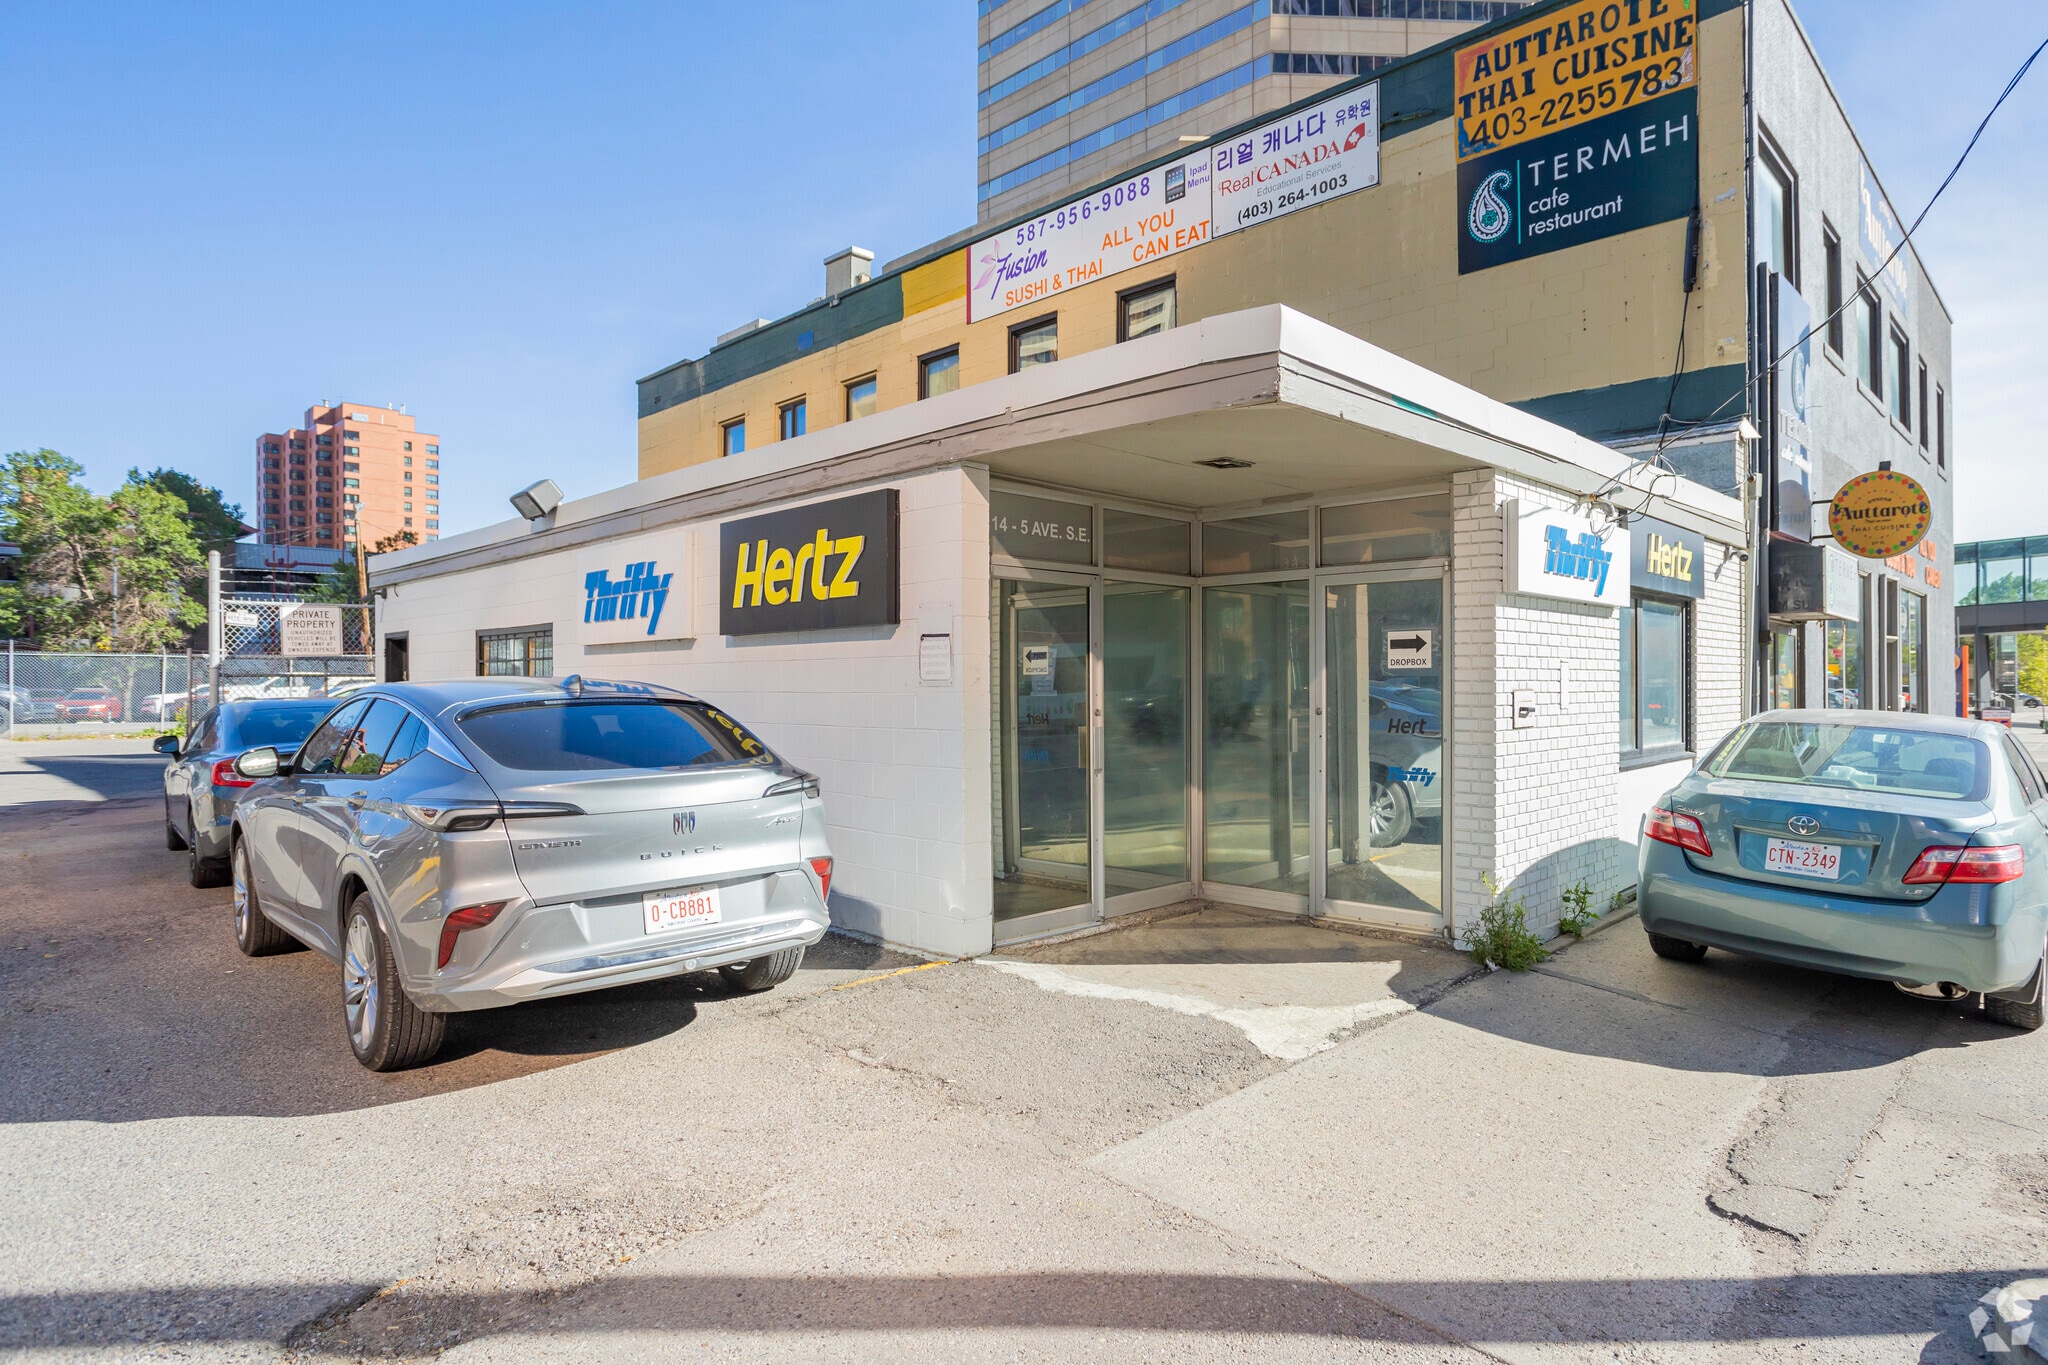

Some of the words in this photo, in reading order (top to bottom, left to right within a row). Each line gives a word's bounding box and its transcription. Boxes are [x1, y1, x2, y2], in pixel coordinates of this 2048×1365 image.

[1473, 0, 1668, 82] AUTTAROTE
[1459, 68, 1535, 120] THAI
[1553, 14, 1693, 85] CUISINE
[1469, 56, 1682, 147] 403-2255783
[1217, 139, 1254, 171] 리얼
[1262, 111, 1327, 155] 캐나다
[1335, 99, 1371, 128] 유학원
[1528, 114, 1689, 187] TERMEH
[1187, 175, 1210, 189] Menu
[1189, 163, 1208, 178] Ipad
[1257, 172, 1304, 197] Educational
[1305, 161, 1342, 180] Services
[1016, 176, 1151, 246] 587-956-9088
[1237, 200, 1273, 225] (403)
[1278, 173, 1348, 208] 264-1003
[1528, 188, 1570, 214] cafe
[1528, 195, 1623, 236] restaurant
[1101, 226, 1134, 251] ALL
[1138, 208, 1175, 237] YOU
[1132, 234, 1169, 263] CAN
[1175, 220, 1210, 249] EAT
[990, 247, 1048, 301] Fusion
[1005, 278, 1048, 307] SUSHI
[1052, 273, 1063, 291] &
[1067, 258, 1103, 285] THAI
[1020, 519, 1028, 535] 5
[1031, 522, 1062, 539] AVE.
[1066, 525, 1091, 543] S.E.
[1840, 503, 1929, 520] Auttarote
[1874, 523, 1911, 531] CUISINE
[732, 528, 866, 609] Hertz
[1544, 524, 1613, 598] Thrifty
[1647, 532, 1693, 583] Hertz
[292, 610, 330, 619] PRIVATE
[584, 560, 673, 636] Thrifty
[286, 620, 335, 628] PROPERTY
[1390, 658, 1427, 666] DROPBOX
[1387, 718, 1427, 734] Hert
[640, 843, 723, 861] BUICK
[1769, 847, 1837, 869] CTN-2349
